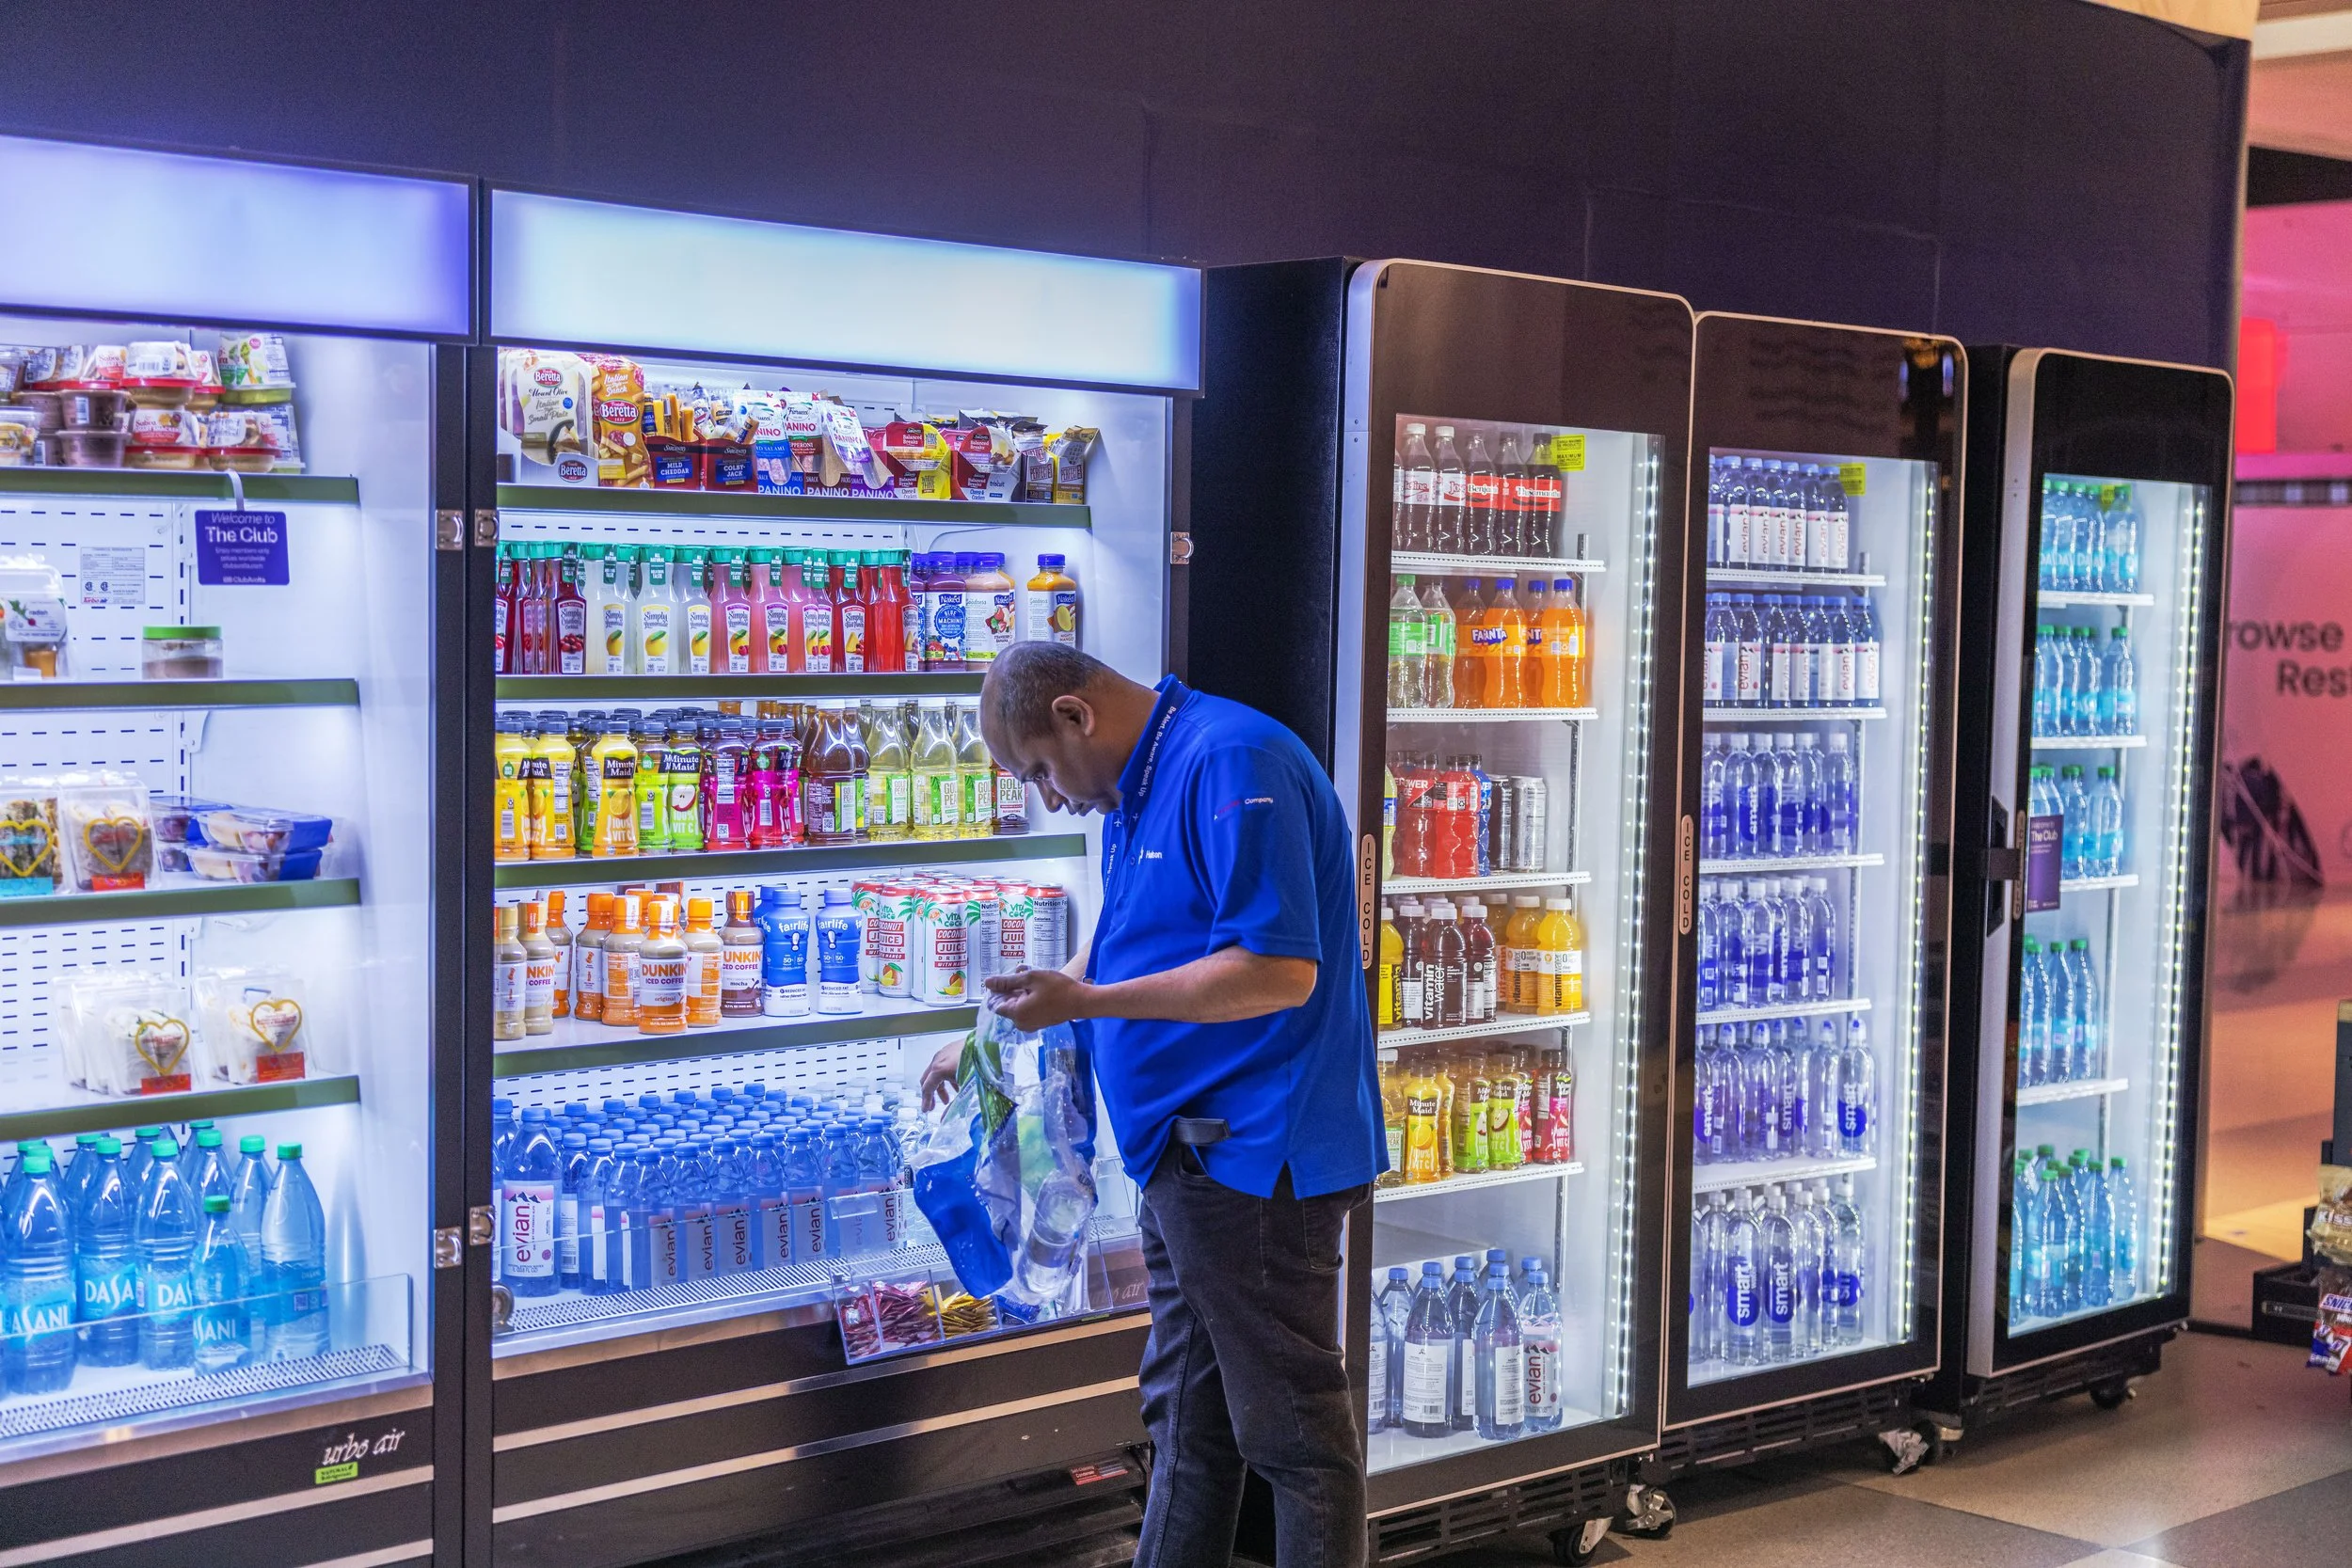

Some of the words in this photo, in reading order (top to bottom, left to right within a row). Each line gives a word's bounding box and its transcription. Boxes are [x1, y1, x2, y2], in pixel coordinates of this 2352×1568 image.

[535, 373, 561, 382] Beretta
[604, 373, 628, 385] Italian
[606, 387, 628, 397] Snack
[601, 405, 638, 419] Beretta
[561, 467, 587, 476] Beretta
[758, 486, 801, 496] PANINO
[807, 487, 850, 498] PANINO
[851, 489, 894, 499] PANINO
[212, 512, 262, 524] Welcome
[264, 514, 275, 524] to
[205, 527, 237, 543] The
[240, 527, 278, 543] Club
[1794, 521, 1803, 557] evian
[561, 610, 581, 619] Simply
[605, 610, 623, 620] Simply
[644, 611, 667, 622] Simply
[691, 612, 708, 622] Simply
[728, 611, 748, 622] Simply
[607, 760, 634, 769] Minute
[670, 753, 699, 764] Minute
[673, 763, 695, 771] Maid
[1142, 764, 1152, 786] Speak
[1000, 778, 1023, 789] GOLD
[1000, 790, 1022, 800] PEAK
[1138, 784, 1147, 797] Up
[1245, 797, 1273, 805] Company
[674, 810, 693, 820] 100%
[673, 823, 687, 833] VIT
[689, 823, 693, 833] C
[613, 830, 625, 842] VIT
[2031, 831, 2042, 842] The
[2043, 830, 2058, 842] Club
[1682, 876, 1691, 928] COLD
[938, 930, 966, 940] COCONUT
[1362, 902, 1372, 961] COLD
[941, 942, 964, 953] JUICE
[662, 977, 685, 986] COFFEE
[1435, 964, 1445, 1004] water
[1392, 966, 1402, 1021] vitamin
[1425, 964, 1434, 1021] vitamin
[654, 995, 676, 1004] original
[1409, 1099, 1436, 1108] Minute
[1783, 1083, 1792, 1131] smart
[1845, 1082, 1856, 1131] smart
[1413, 1107, 1432, 1116] Maid
[885, 1197, 896, 1243] evian
[513, 1205, 531, 1262] evian
[779, 1213, 788, 1259] evian
[812, 1209, 821, 1254] evian
[703, 1226, 713, 1271] evian
[736, 1220, 746, 1266] evian
[667, 1231, 677, 1276] evian
[86, 1275, 135, 1308] DASA
[1735, 1263, 1750, 1319] smart
[1775, 1261, 1788, 1316] smart
[1528, 1354, 1541, 1405] evian
[373, 1428, 405, 1455] air
